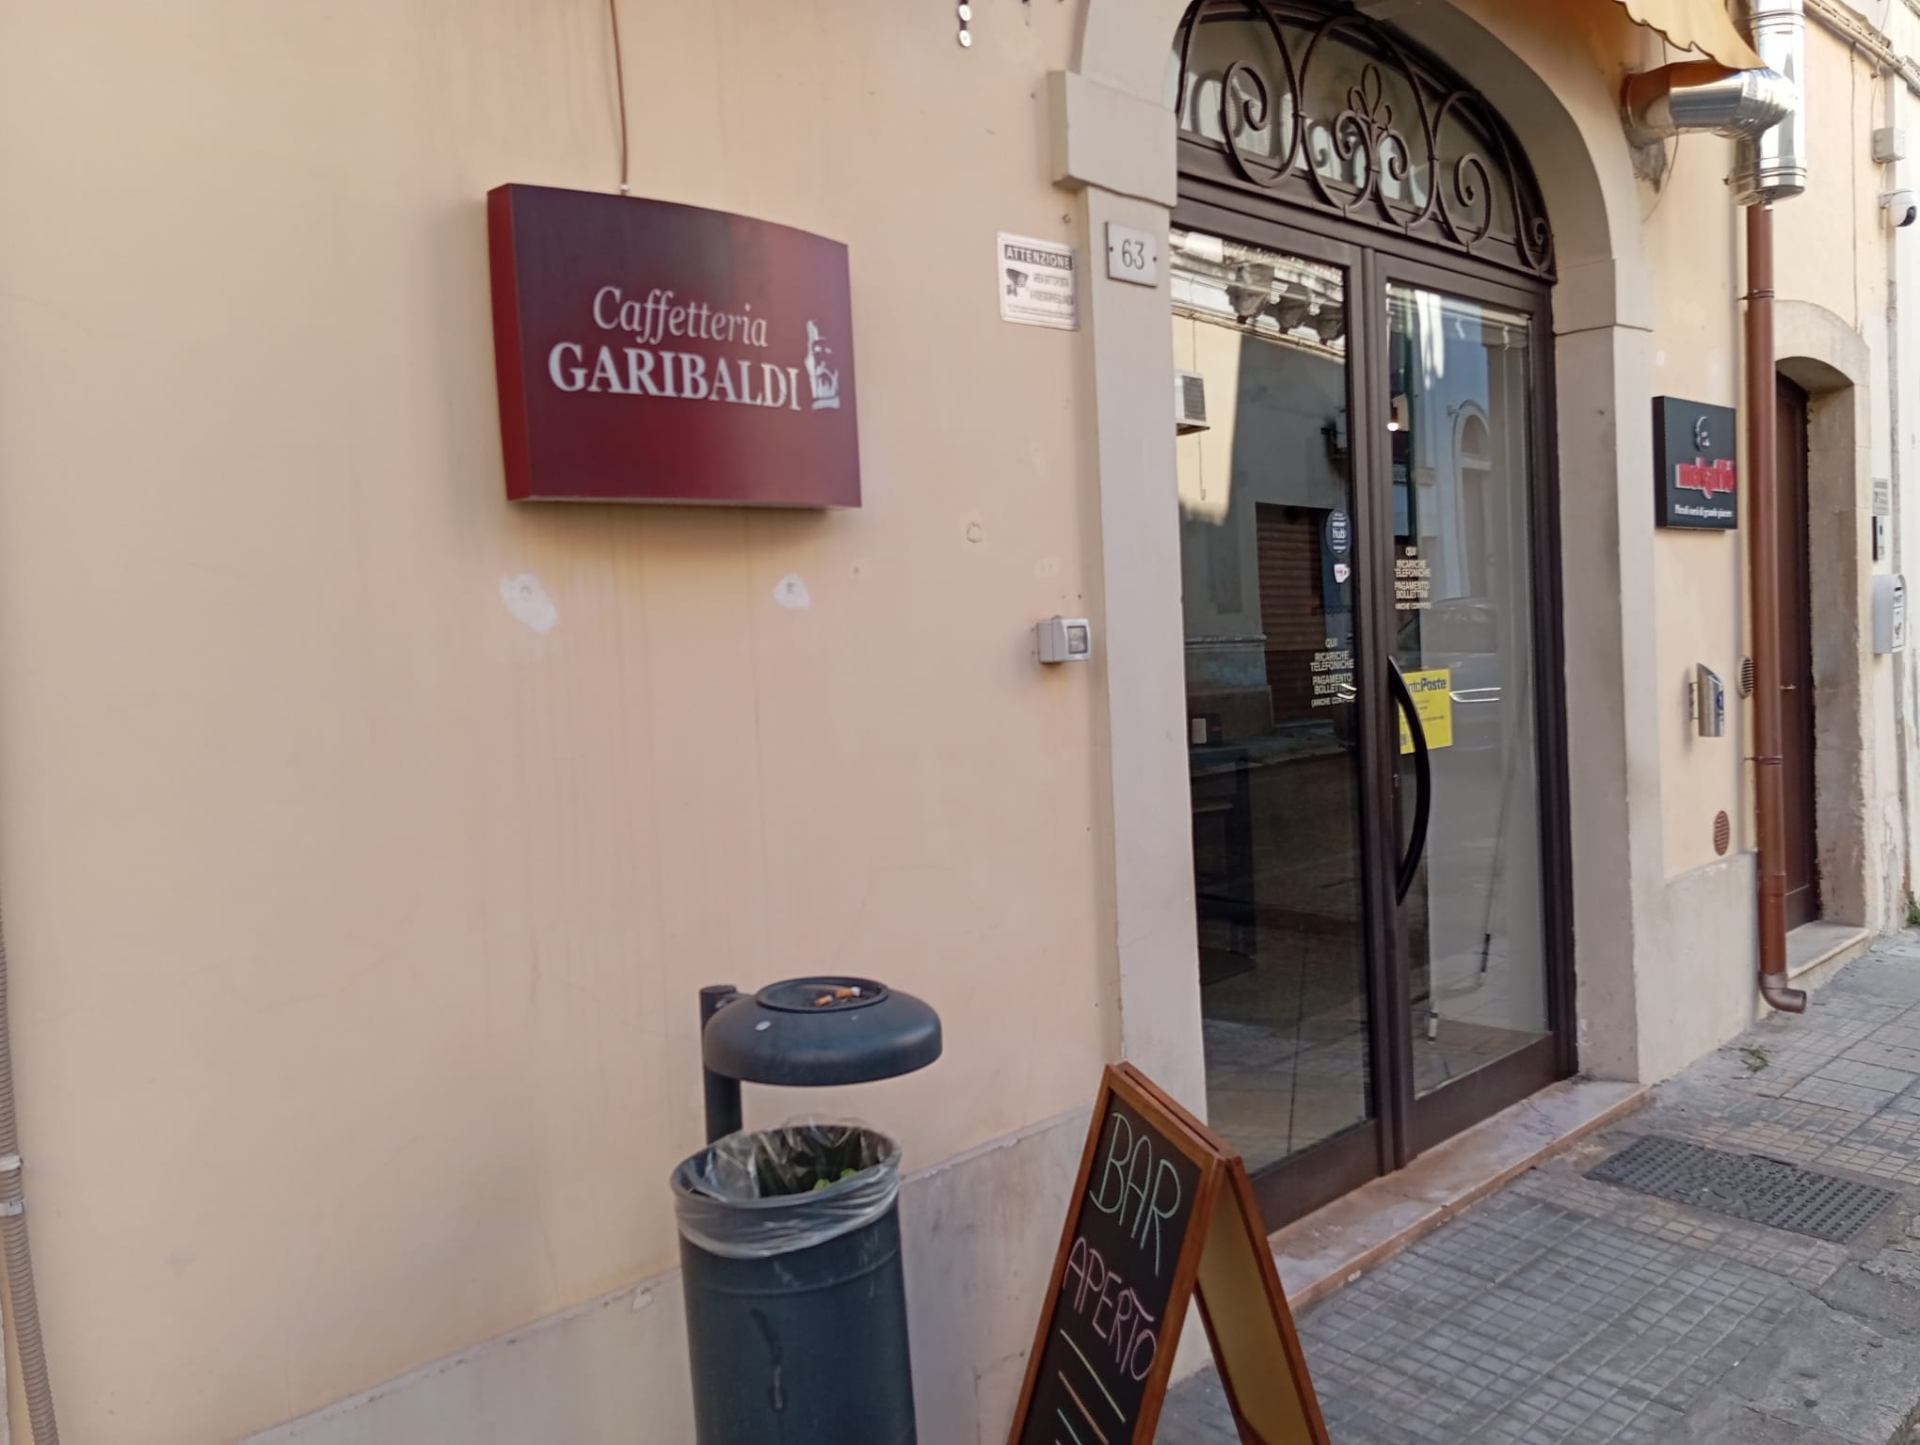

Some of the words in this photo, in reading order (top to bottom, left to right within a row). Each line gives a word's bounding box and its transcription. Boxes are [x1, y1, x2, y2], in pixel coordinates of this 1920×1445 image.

[1005, 245, 1073, 270] ATTENZIONE
[1121, 239, 1145, 270] 63
[593, 286, 768, 347] Caffetteria
[549, 342, 801, 410] GARIBALDI
[1325, 638, 1338, 649] QUI
[1310, 658, 1355, 672] TELEFONICHE
[1312, 673, 1353, 687] PAGAMENTO
[1089, 1111, 1181, 1277] BAR
[1062, 1236, 1158, 1381] APERTO
